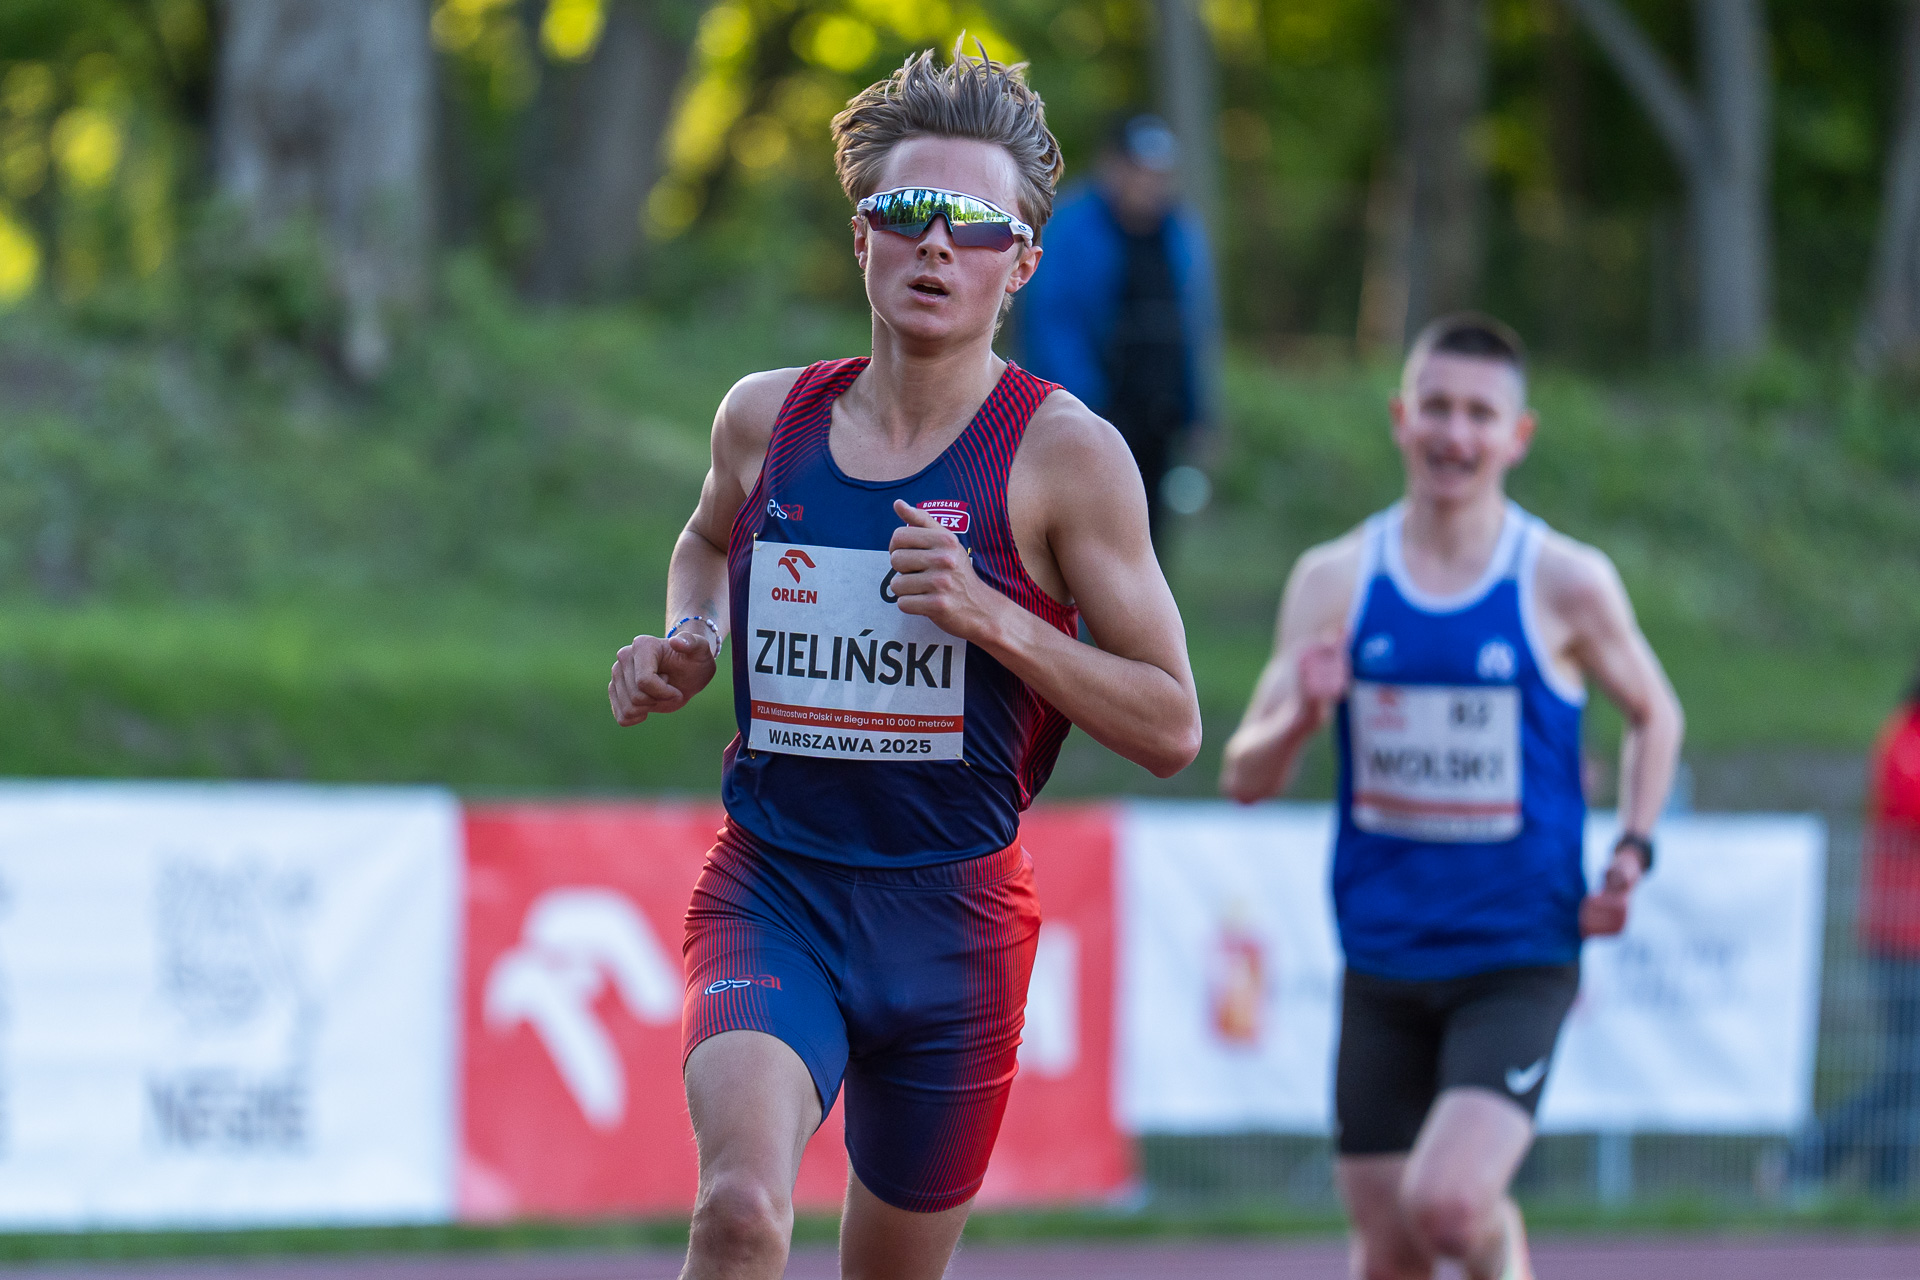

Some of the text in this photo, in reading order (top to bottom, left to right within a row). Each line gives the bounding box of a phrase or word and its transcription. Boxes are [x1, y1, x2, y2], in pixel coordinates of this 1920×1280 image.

[771, 587, 818, 604] ORLEN
[755, 629, 953, 688] ZIELIŃSKI
[757, 705, 770, 714] PZLA
[771, 707, 808, 719] Mistrzostwa
[809, 712, 833, 721] Polski
[843, 714, 869, 726] Biegu
[871, 717, 884, 726] na
[886, 717, 896, 726] 10
[898, 718, 916, 727] 000
[918, 718, 955, 728] metrów
[769, 728, 932, 753] WARSZAWA 2025
